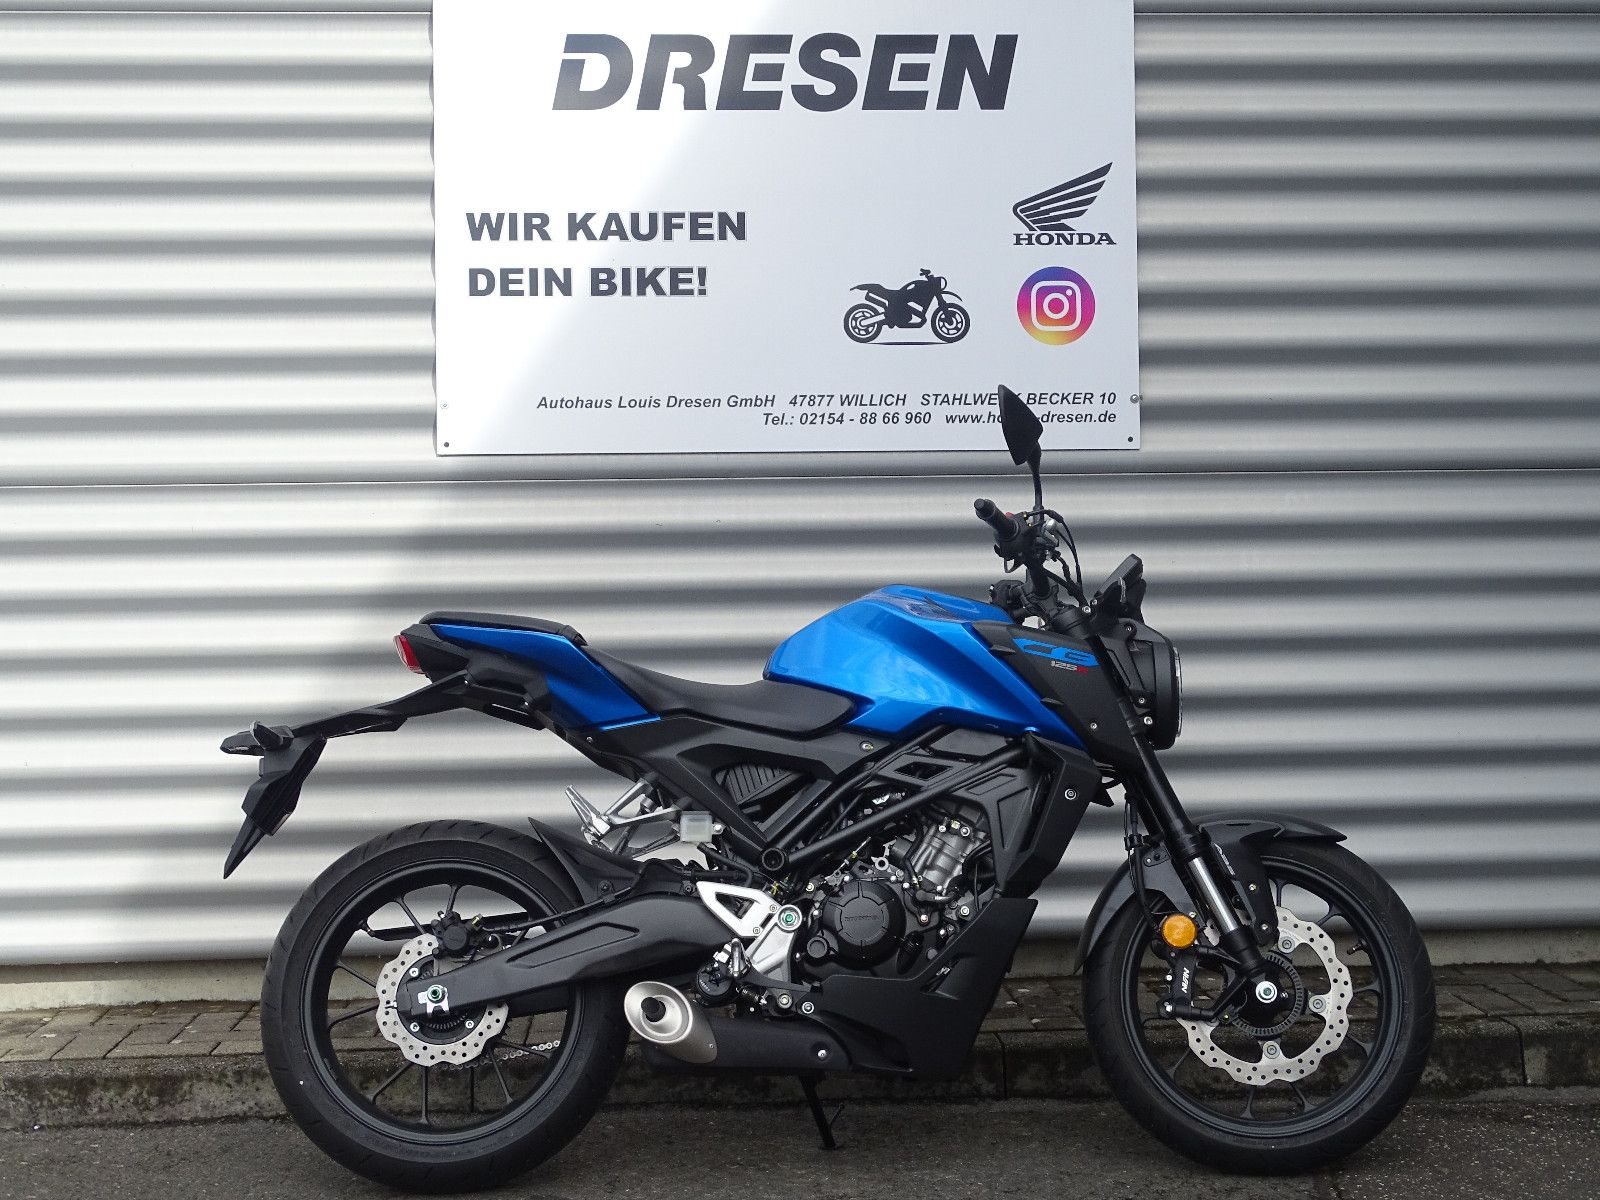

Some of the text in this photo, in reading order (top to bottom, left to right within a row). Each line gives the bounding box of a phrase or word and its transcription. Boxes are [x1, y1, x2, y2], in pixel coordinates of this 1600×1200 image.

[552, 33, 1018, 112] DRESEN
[466, 211, 748, 243] WIR KAUFEN
[1013, 232, 1117, 246] HONDA
[469, 266, 708, 297] DEIN BIKE!
[537, 392, 1117, 409] Autohaus Louis Dresen GmbH 47877 WILLICH STAHLWE BECKER 10
[763, 412, 795, 426] Tel.:
[799, 412, 845, 426] 02154
[859, 412, 878, 425] 88
[882, 412, 900, 425] 66
[904, 411, 932, 425] 960
[945, 410, 1117, 425] www.ho-dresen.de
